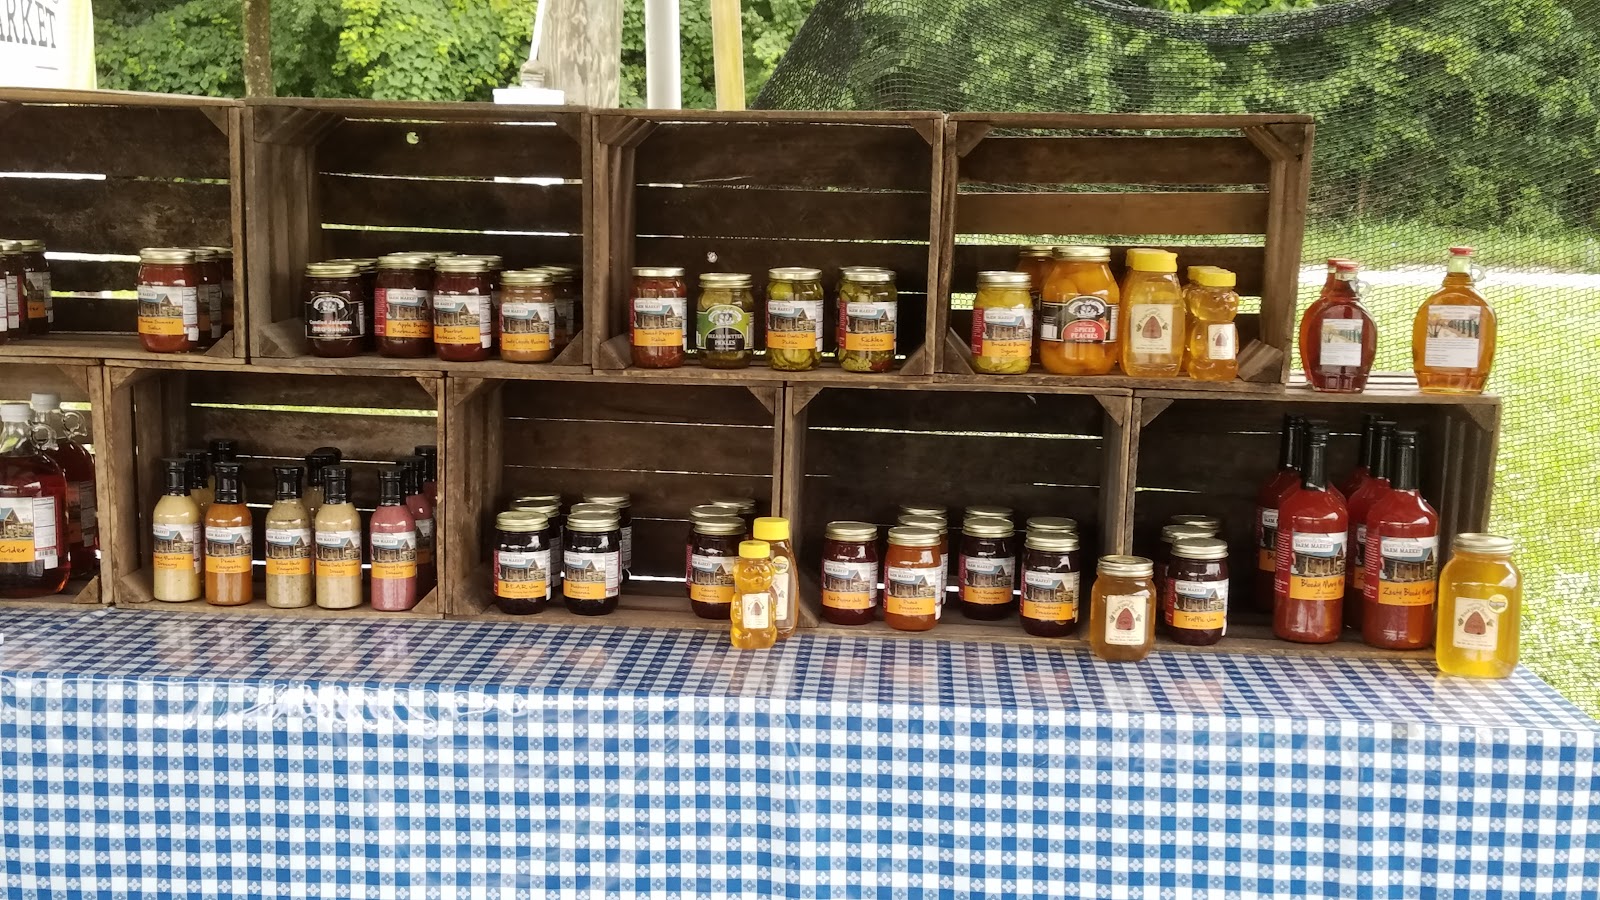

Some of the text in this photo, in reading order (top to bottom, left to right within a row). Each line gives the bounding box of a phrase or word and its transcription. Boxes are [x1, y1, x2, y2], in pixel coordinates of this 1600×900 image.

[0, 545, 27, 554] Cider
[1301, 578, 1321, 591] Bloody
[1322, 579, 1337, 590] Mary
[1382, 587, 1402, 599] Zesty
[1403, 587, 1421, 599] Bloody
